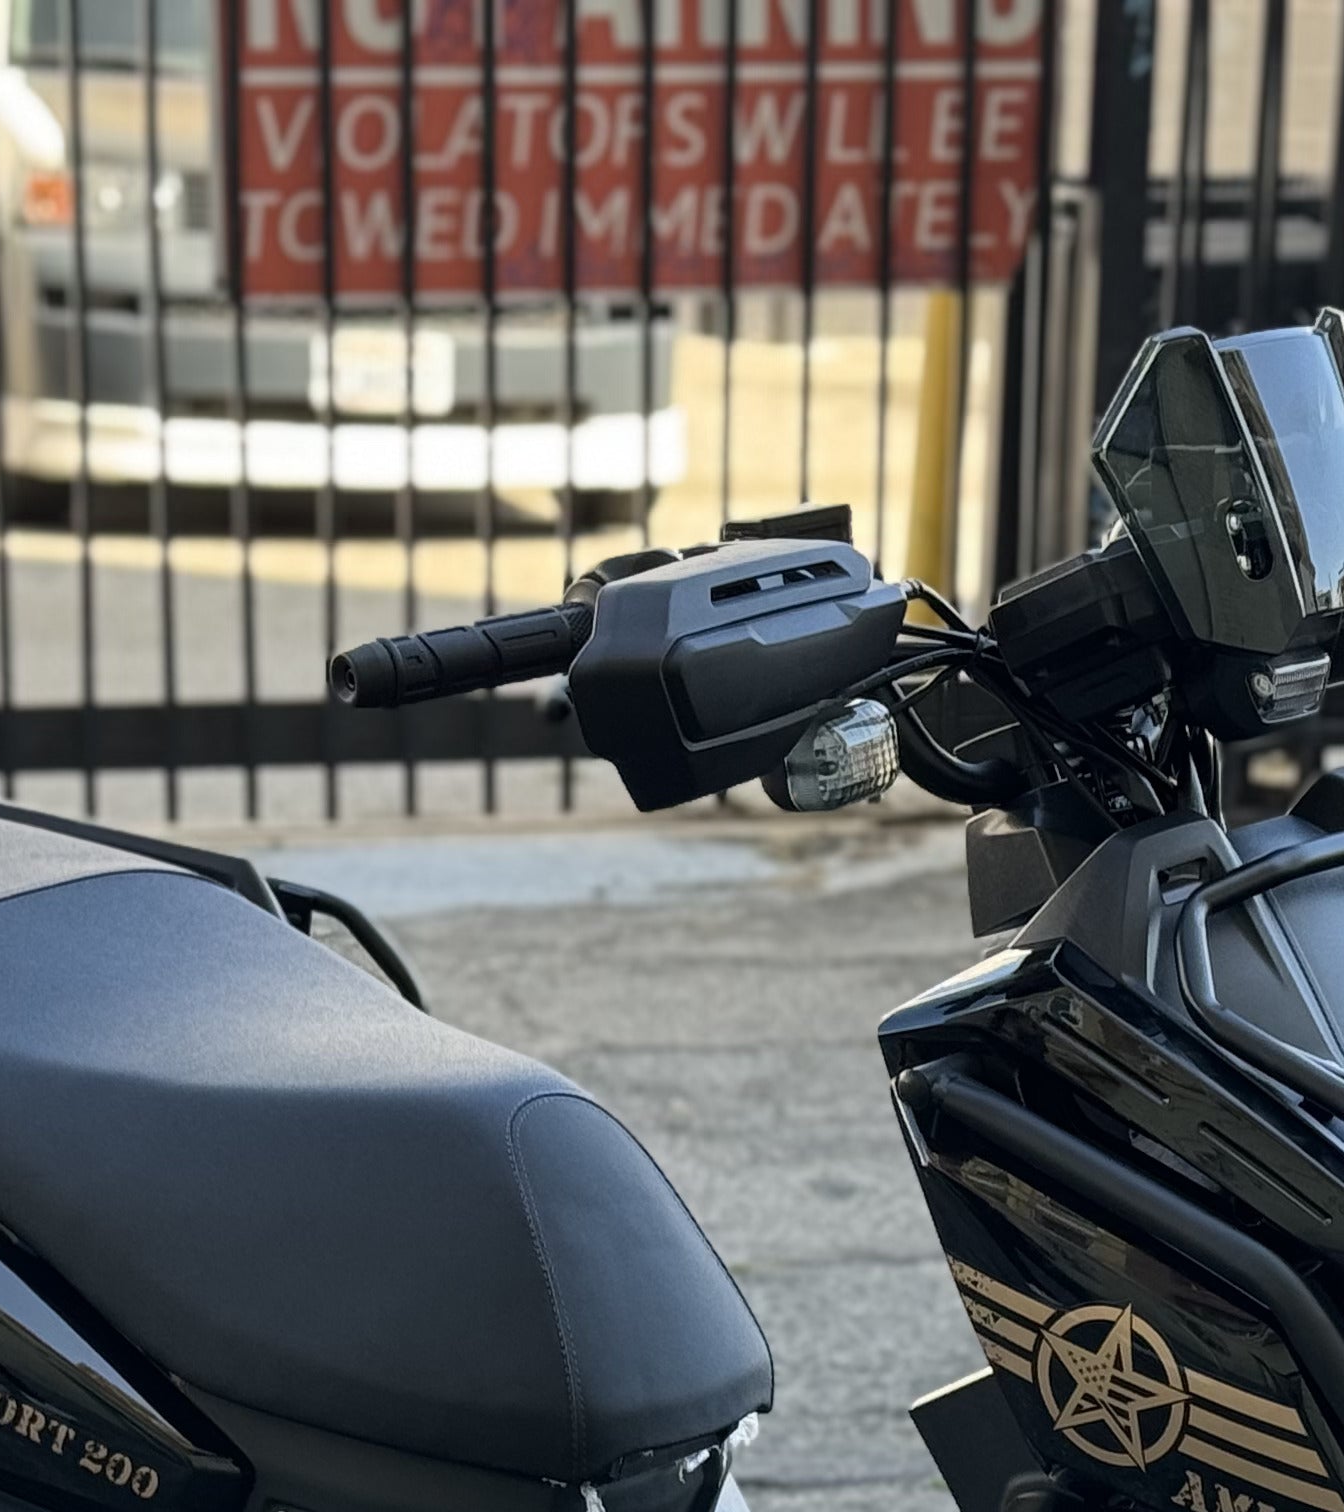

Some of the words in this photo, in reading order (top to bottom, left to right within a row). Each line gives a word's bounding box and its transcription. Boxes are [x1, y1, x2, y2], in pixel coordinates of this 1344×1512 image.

[256, 92, 708, 172] VOLATORS
[732, 89, 909, 167] WLL
[239, 186, 520, 264] TOWED
[80, 1440, 159, 1499] 200
